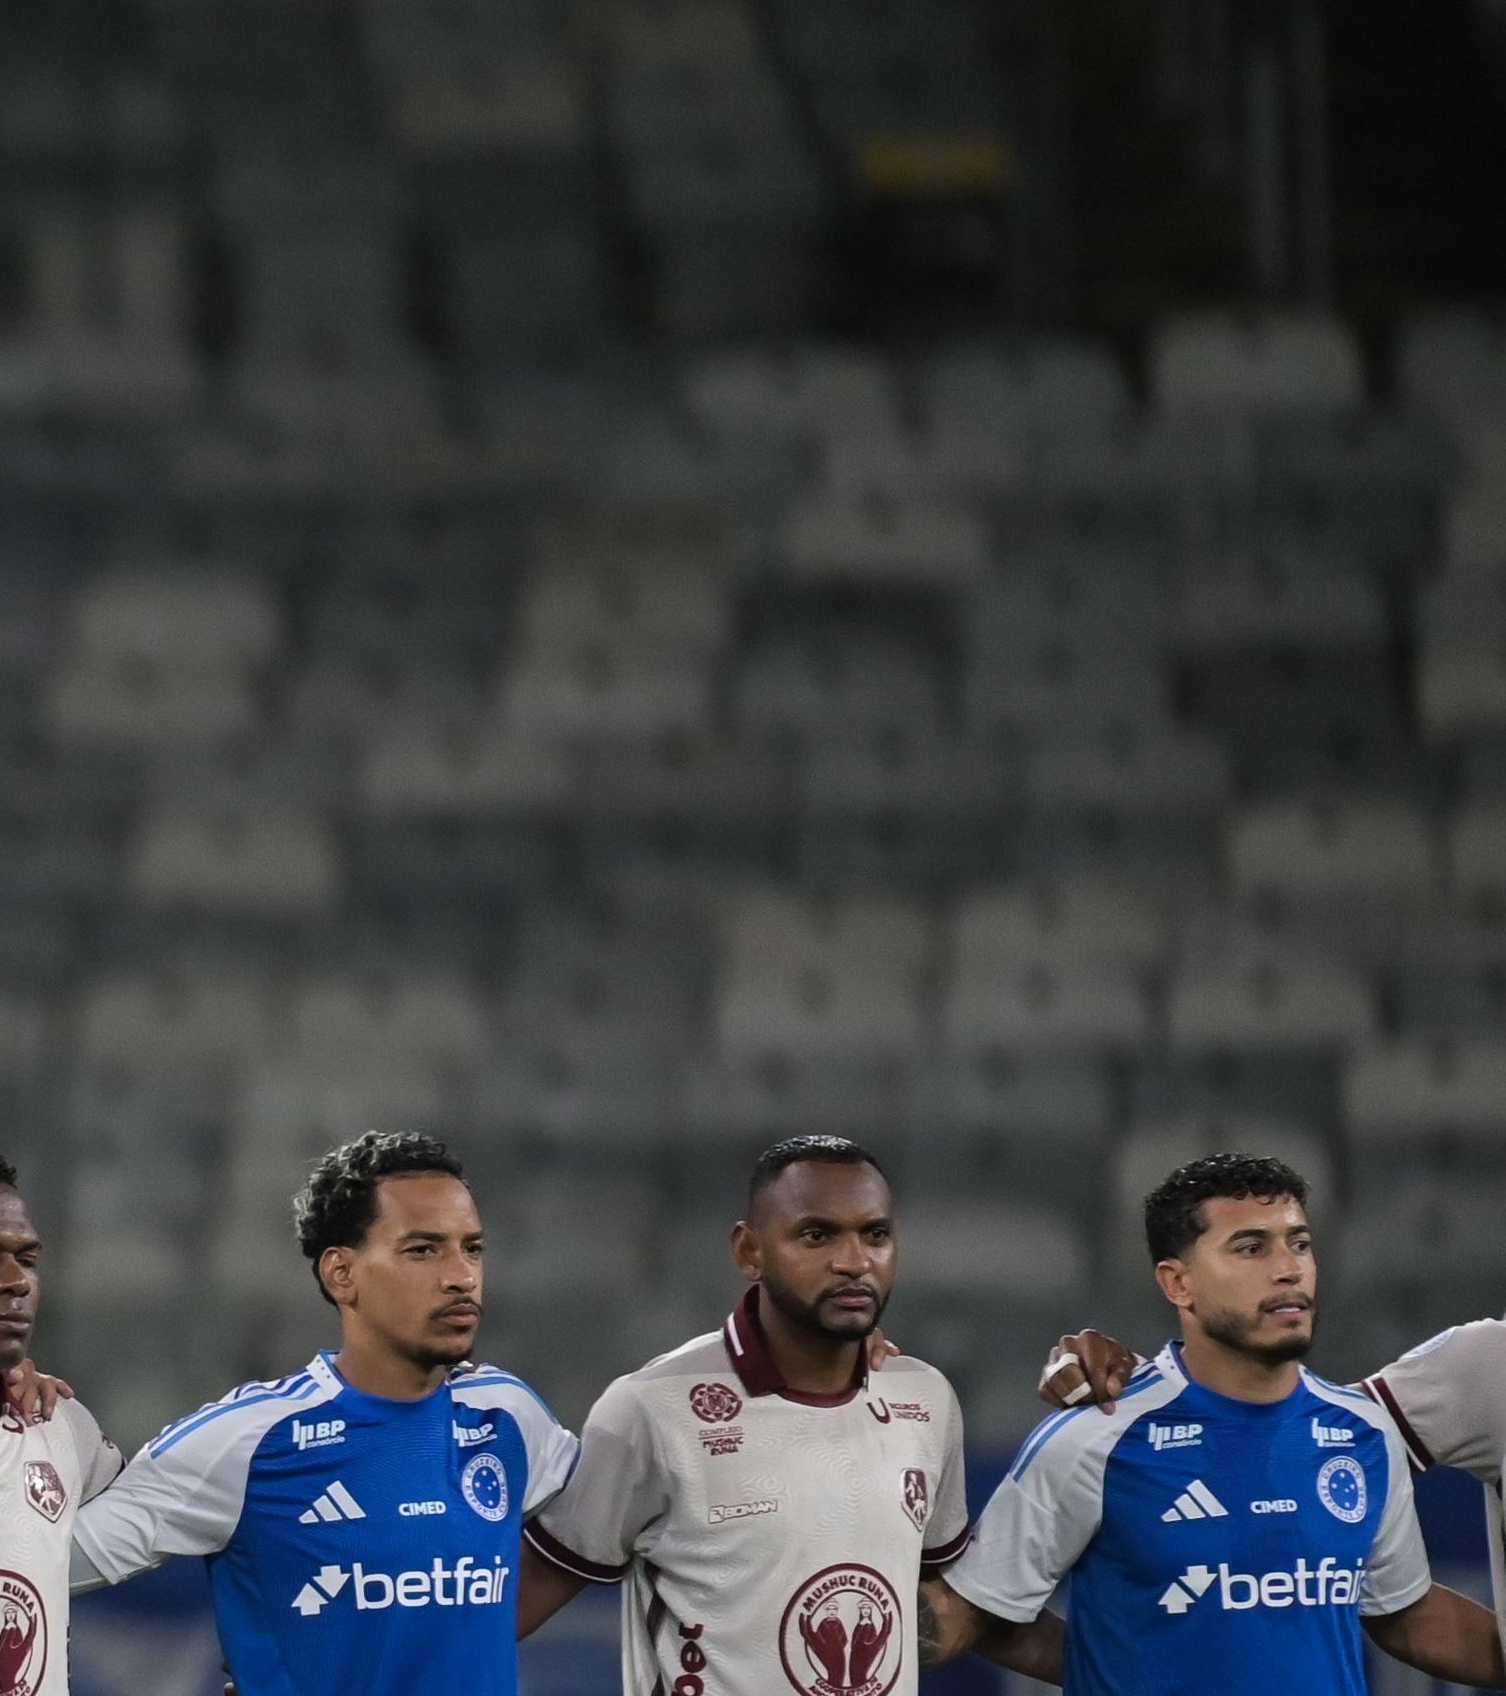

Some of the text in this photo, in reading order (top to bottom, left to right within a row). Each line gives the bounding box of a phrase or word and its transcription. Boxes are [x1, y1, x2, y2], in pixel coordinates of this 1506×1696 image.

[464, 1457, 502, 1480] CRUZEIRO
[1321, 1458, 1362, 1482] CRUZEIRO
[398, 1500, 447, 1517] CIMED
[724, 1500, 778, 1519] BOMAN
[1249, 1498, 1298, 1515] CIMED
[352, 1555, 510, 1610] betfair
[2, 1580, 36, 1617] RUNA
[803, 1574, 893, 1615] MUSHUC RUNA
